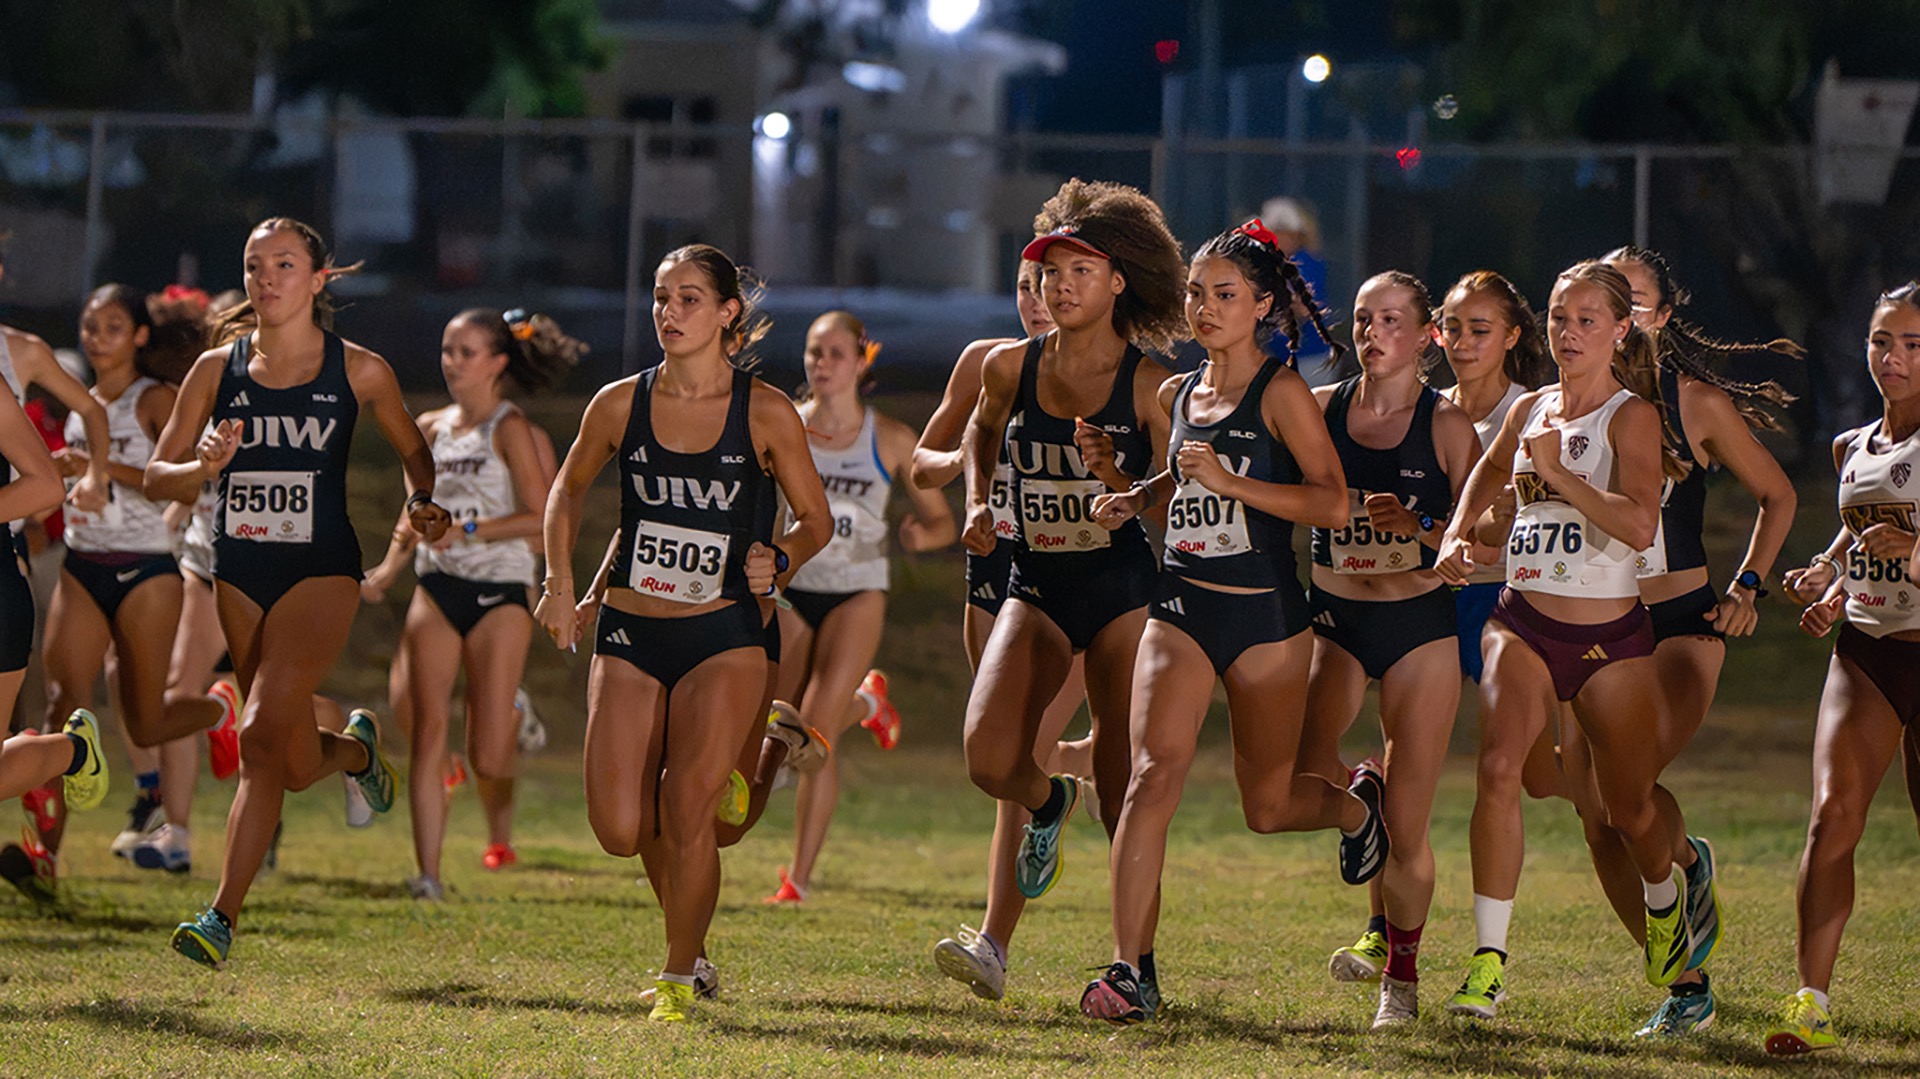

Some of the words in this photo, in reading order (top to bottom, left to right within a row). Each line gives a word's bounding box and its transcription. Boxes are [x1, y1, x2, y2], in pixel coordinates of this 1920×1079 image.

[229, 484, 308, 513] 5508
[631, 473, 741, 511] UIW
[1170, 495, 1236, 530] 5507
[637, 533, 722, 576] 5503
[1510, 522, 1582, 556] 5576
